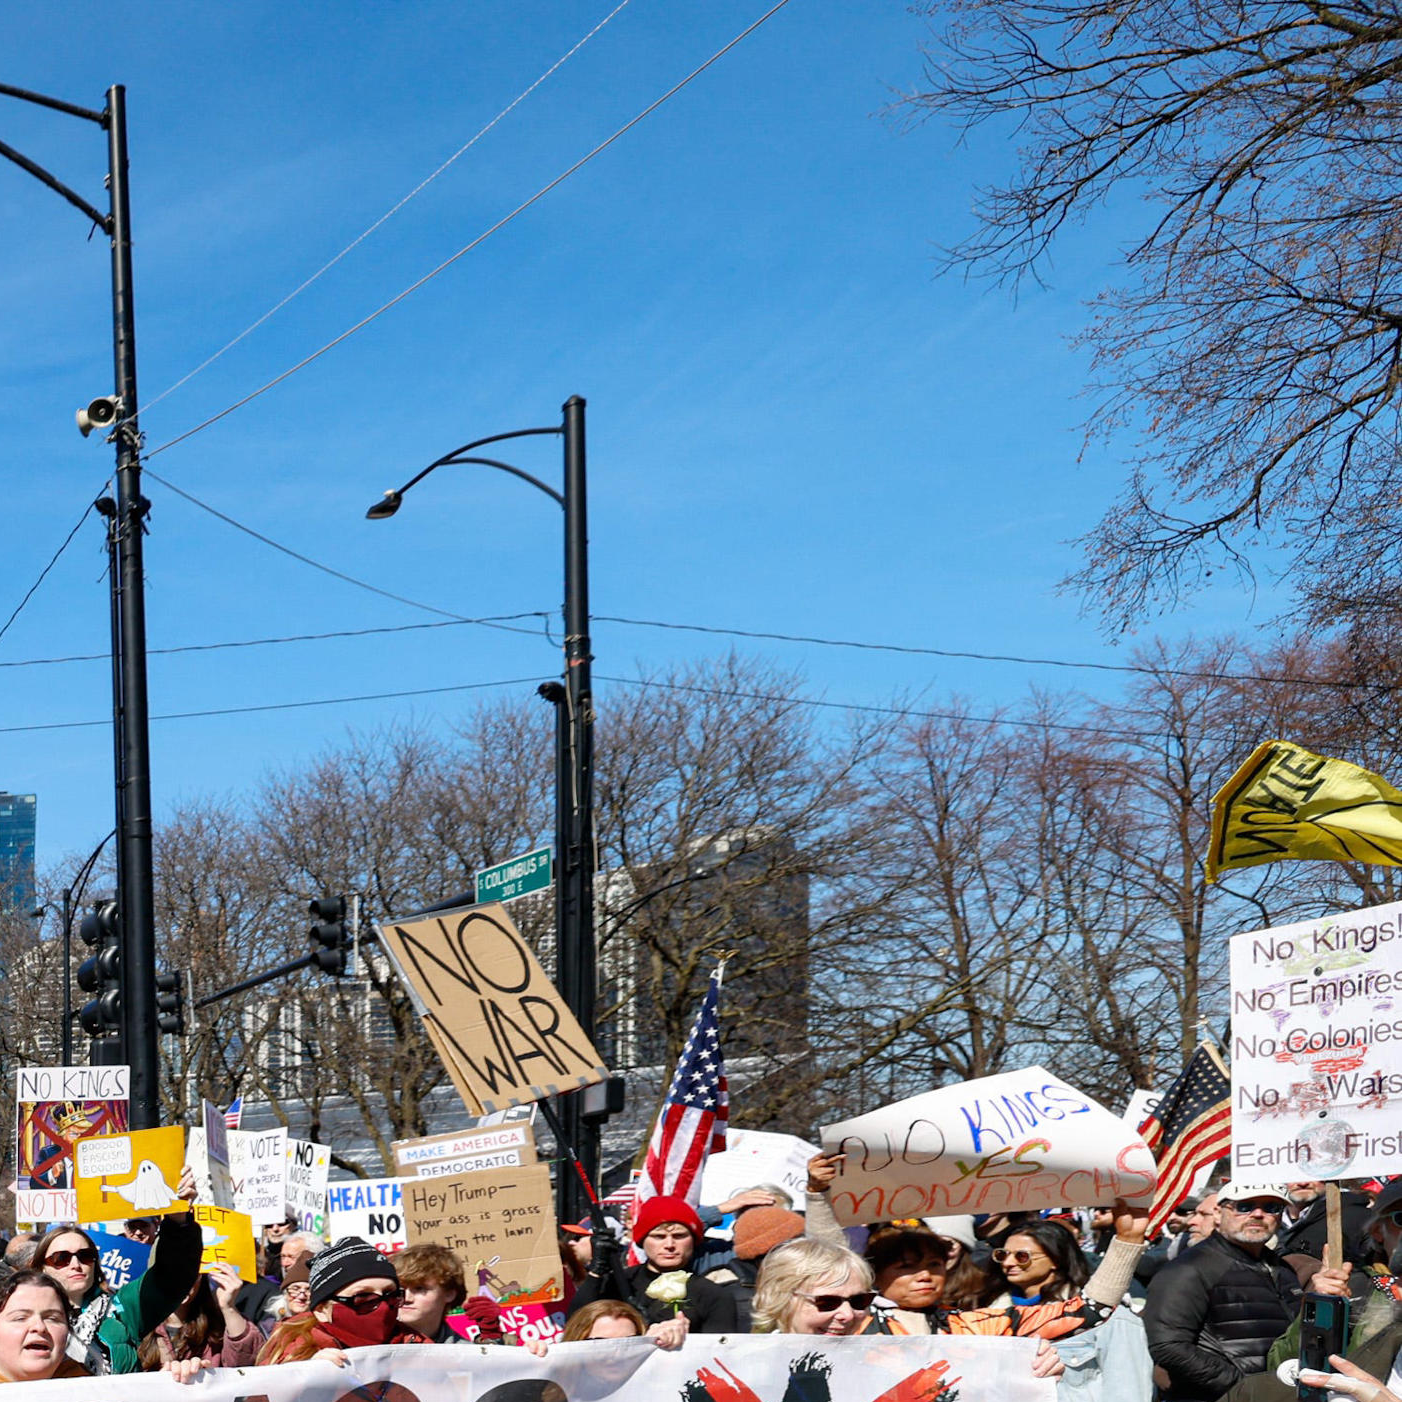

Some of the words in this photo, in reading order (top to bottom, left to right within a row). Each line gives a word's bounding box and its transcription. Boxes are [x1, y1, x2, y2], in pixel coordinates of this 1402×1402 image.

[485, 857, 537, 890] COLUMBUS
[517, 880, 523, 892] E
[395, 912, 531, 1007] NO
[1252, 937, 1294, 965] No
[1235, 988, 1276, 1015] No
[1289, 970, 1402, 1007] Empires
[427, 996, 595, 1095] WAR
[1235, 1034, 1276, 1060] No
[1286, 1018, 1402, 1054] Colonies
[21, 1071, 52, 1099] NO
[63, 1069, 125, 1098] KINGS
[1238, 1084, 1279, 1109] No
[1326, 1072, 1402, 1101] Wars
[839, 1119, 946, 1177] NO
[960, 1084, 1092, 1154] KINGS
[82, 1150, 125, 1164] FASCISM
[249, 1134, 281, 1160] VOTE
[295, 1142, 314, 1168] NO
[405, 1145, 446, 1162] MAKE
[452, 1132, 521, 1153] AMERICA
[1235, 1138, 1312, 1168] Earth
[1344, 1131, 1402, 1161] First
[257, 1163, 269, 1173] AND
[420, 1153, 517, 1177] DEMOCRATIC
[949, 1137, 1052, 1185] YES
[262, 1173, 281, 1184] PEOPLE
[290, 1166, 312, 1187] MORE
[18, 1193, 44, 1217] NO
[248, 1195, 279, 1210] OVERCOME
[329, 1183, 402, 1213] HEALTH
[412, 1187, 447, 1213] Hey
[196, 1206, 231, 1224] ELT
[368, 1213, 401, 1236] NO
[448, 1215, 471, 1225] ass
[480, 1211, 491, 1221] is
[502, 1204, 541, 1224] grass
[444, 1234, 468, 1250] I'm
[472, 1232, 497, 1245] the
[505, 1226, 533, 1239] lawn
[101, 1248, 133, 1272] the
[100, 1266, 132, 1289] PLE
